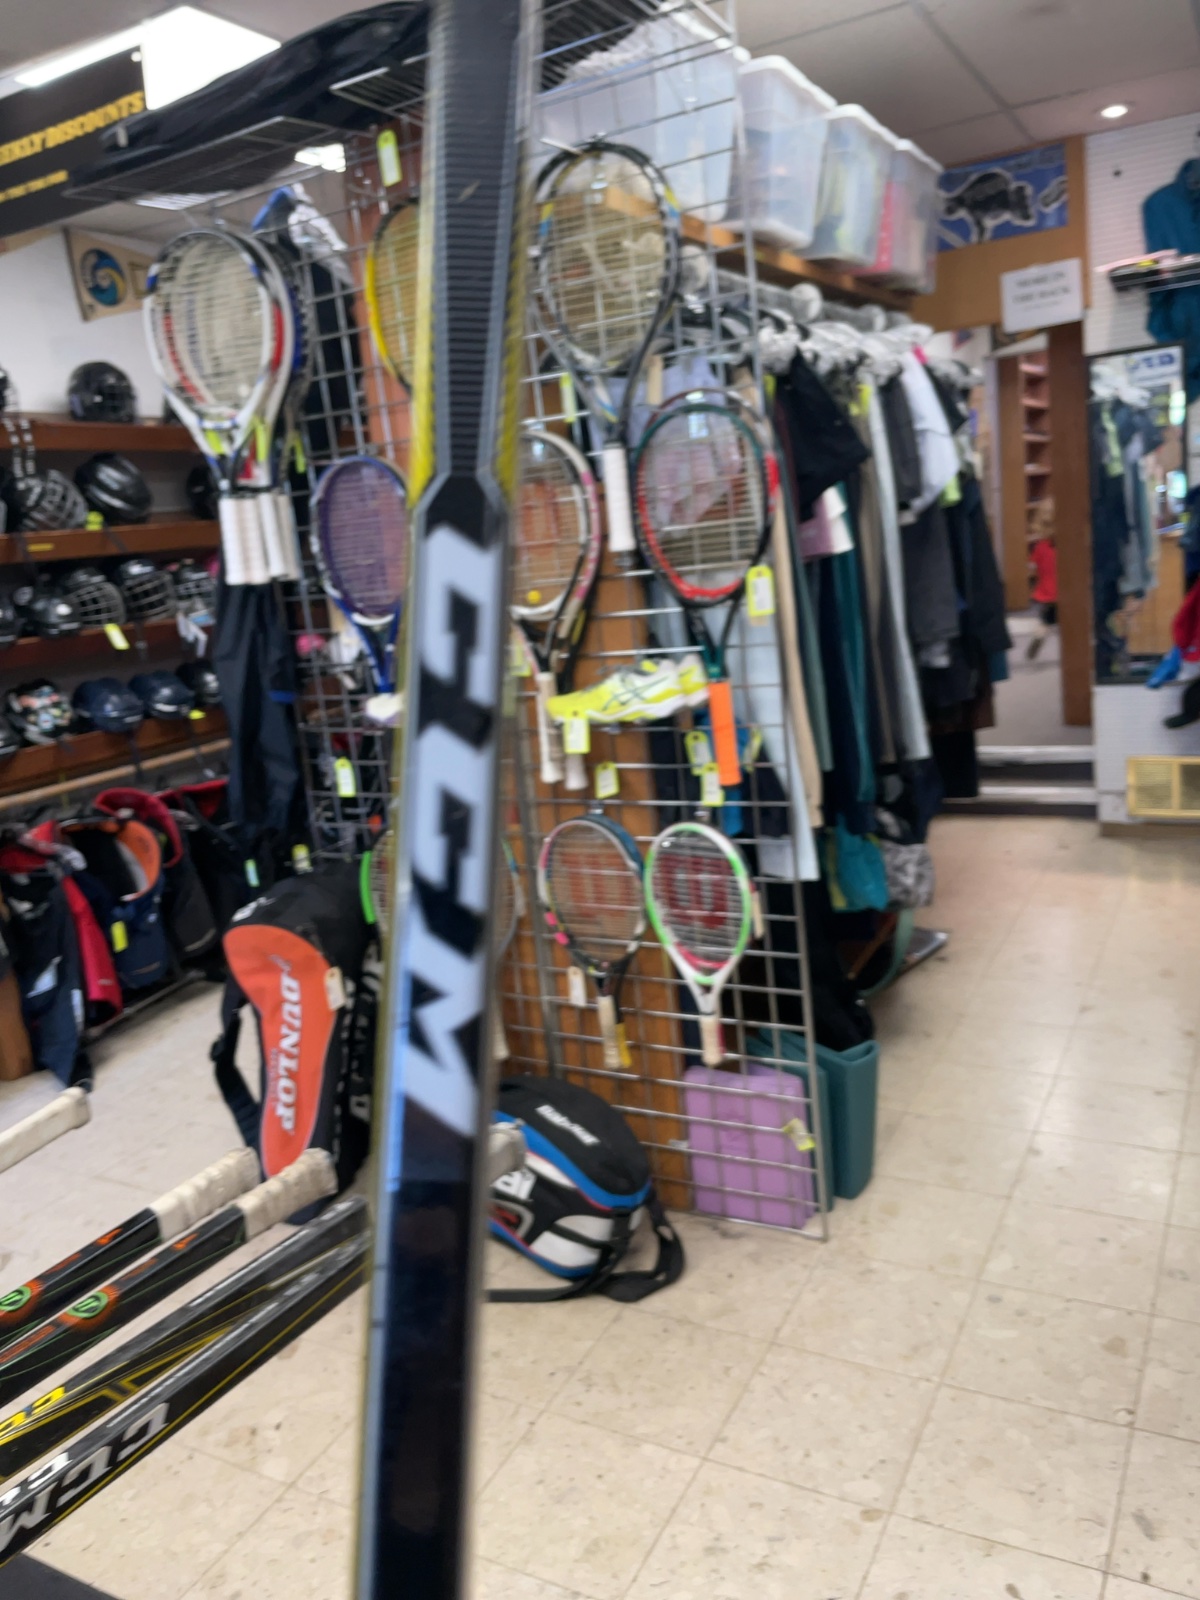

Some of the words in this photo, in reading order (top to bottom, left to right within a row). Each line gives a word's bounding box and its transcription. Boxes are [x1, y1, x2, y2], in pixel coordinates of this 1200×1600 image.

[402, 525, 500, 1136] CCM
[275, 970, 302, 1133] DUNLOP
[0, 1402, 169, 1551] CCM
